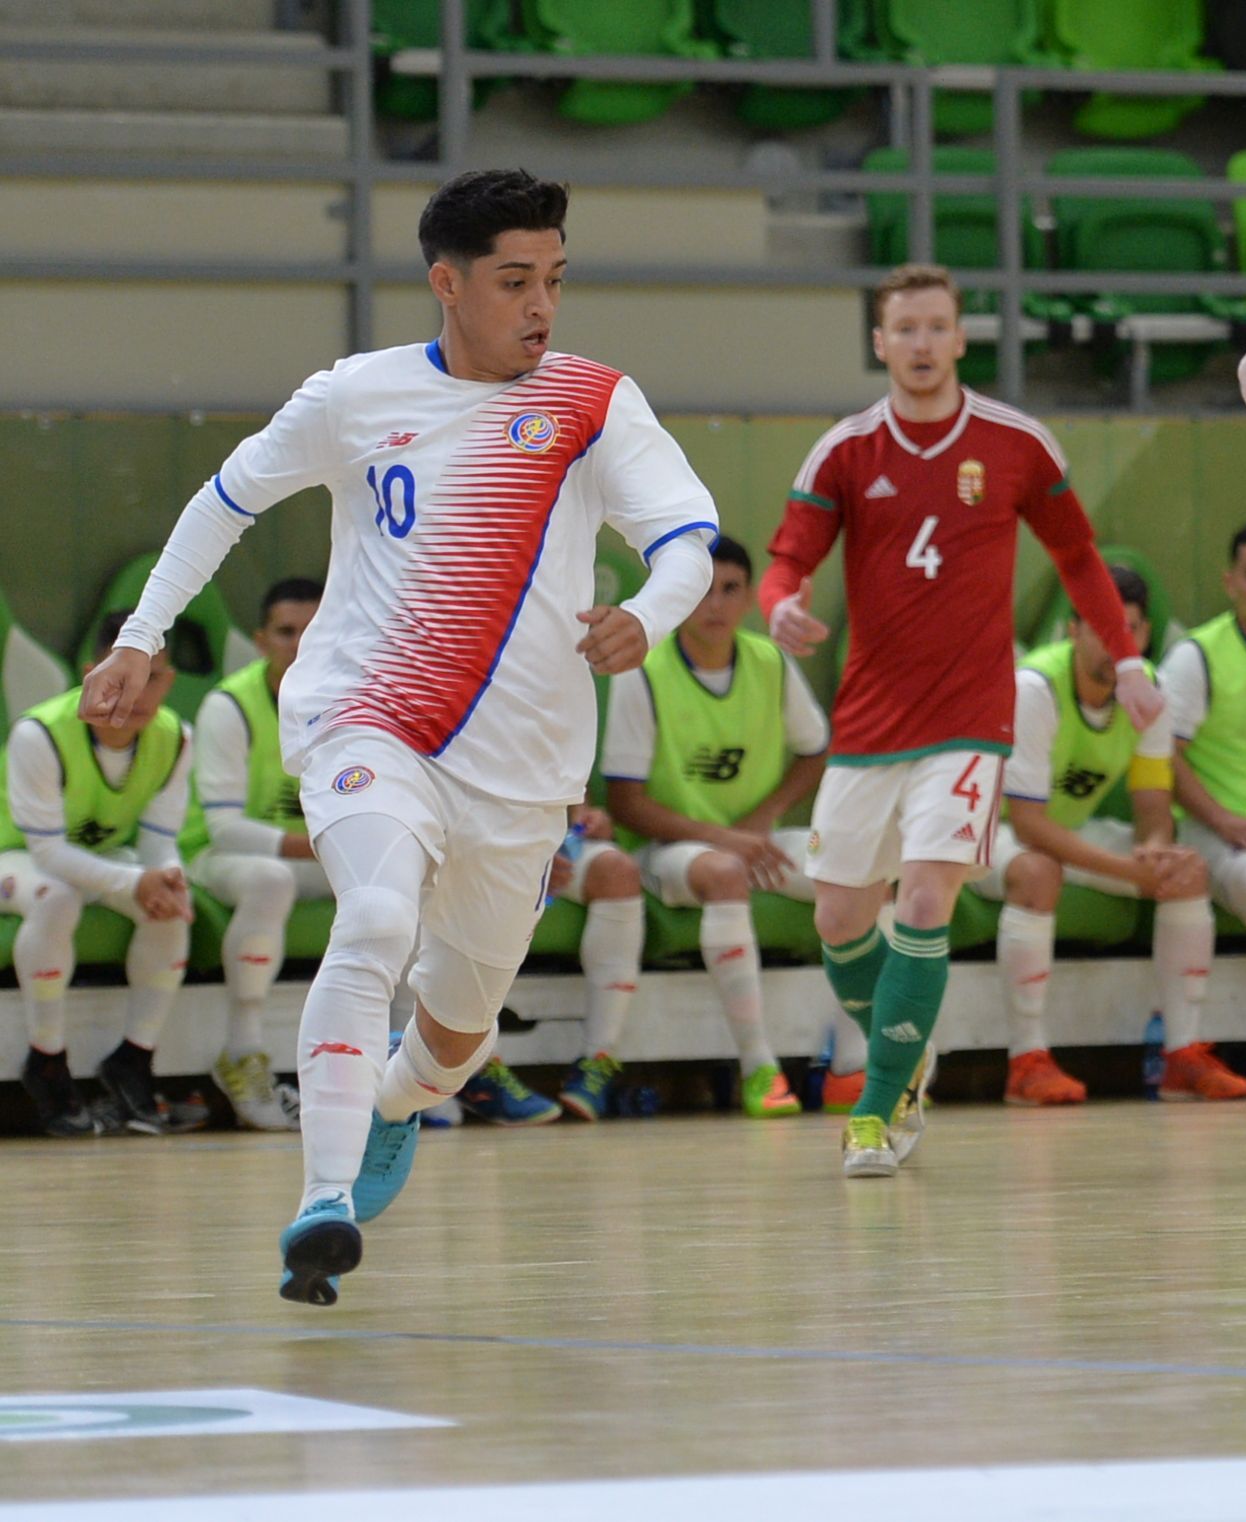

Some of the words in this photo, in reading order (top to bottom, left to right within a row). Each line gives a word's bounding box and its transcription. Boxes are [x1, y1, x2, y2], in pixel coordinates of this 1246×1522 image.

[366, 464, 416, 539] 10
[906, 515, 943, 579] 4
[951, 754, 981, 812] 4
